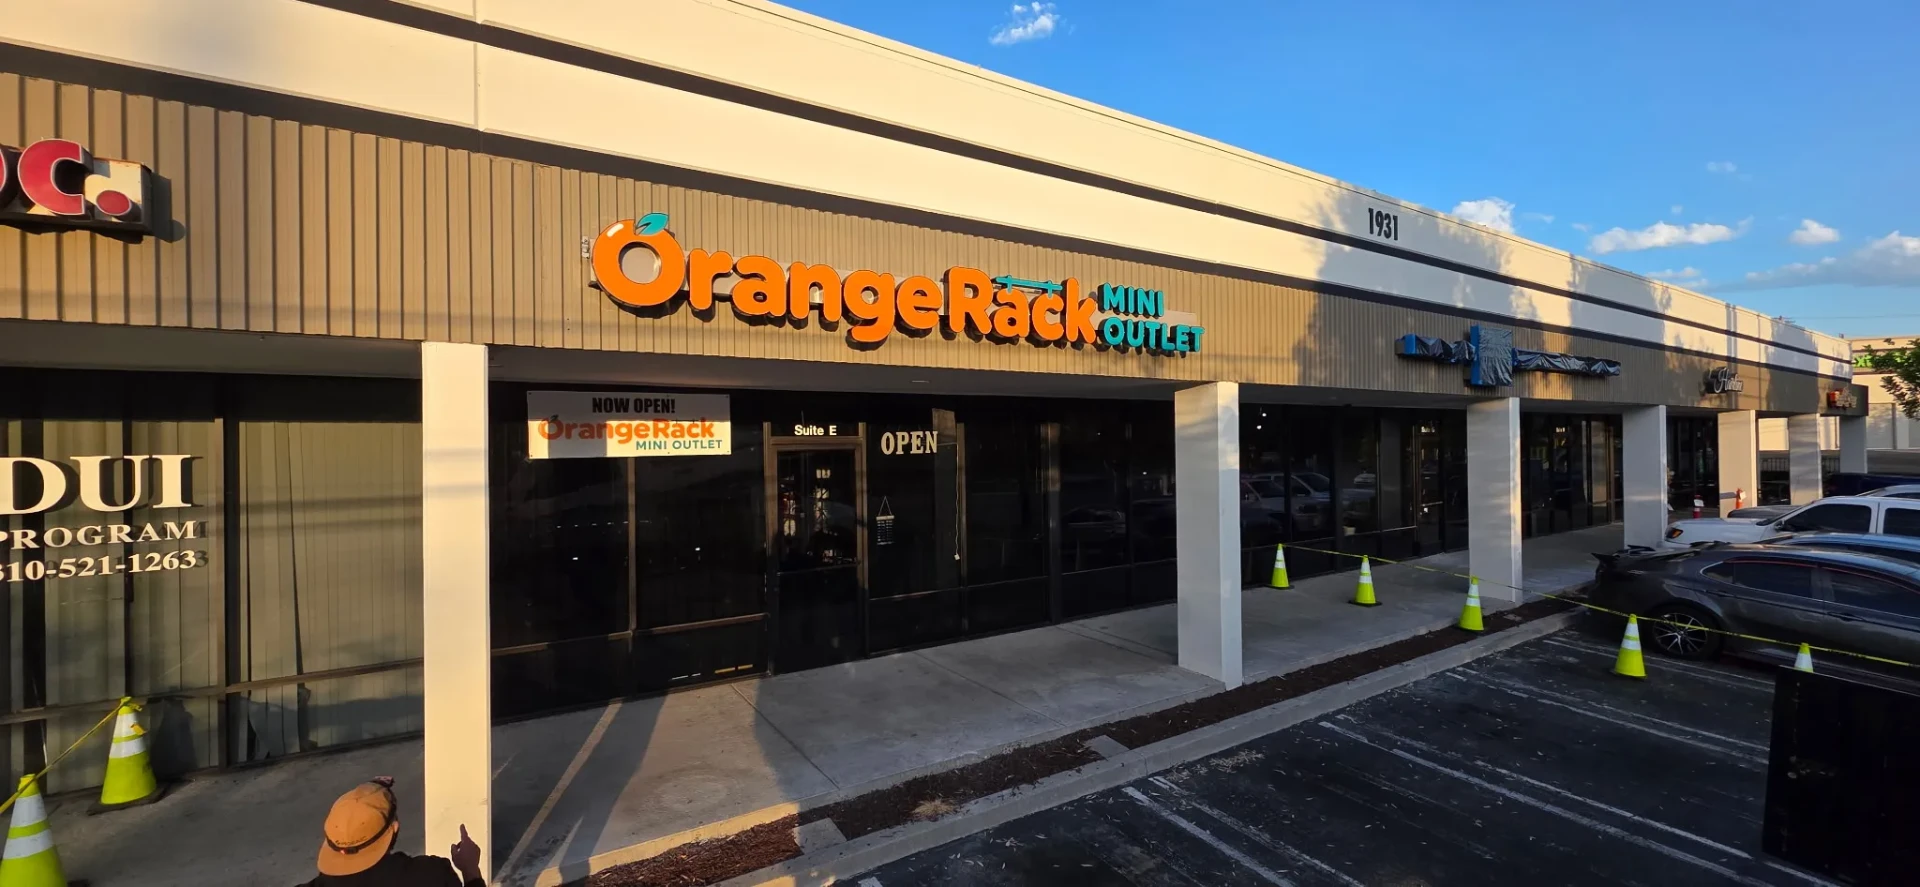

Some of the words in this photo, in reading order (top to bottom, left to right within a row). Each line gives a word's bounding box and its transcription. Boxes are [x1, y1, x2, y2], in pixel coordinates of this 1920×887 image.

[0, 138, 131, 215] C.
[1368, 207, 1399, 241] 1931
[591, 213, 1097, 343] OrangeRack
[1103, 282, 1164, 317] MINI
[1103, 317, 1206, 352] OUTLET
[592, 397, 630, 413] NOW
[633, 397, 676, 413] OPEN!
[538, 415, 715, 444] OrangeRack
[636, 440, 667, 450] MINI
[672, 439, 722, 449] OUTLET
[794, 424, 825, 436] Suite
[829, 425, 837, 436] E
[880, 431, 938, 455] OPEN
[0, 454, 192, 515] DUI
